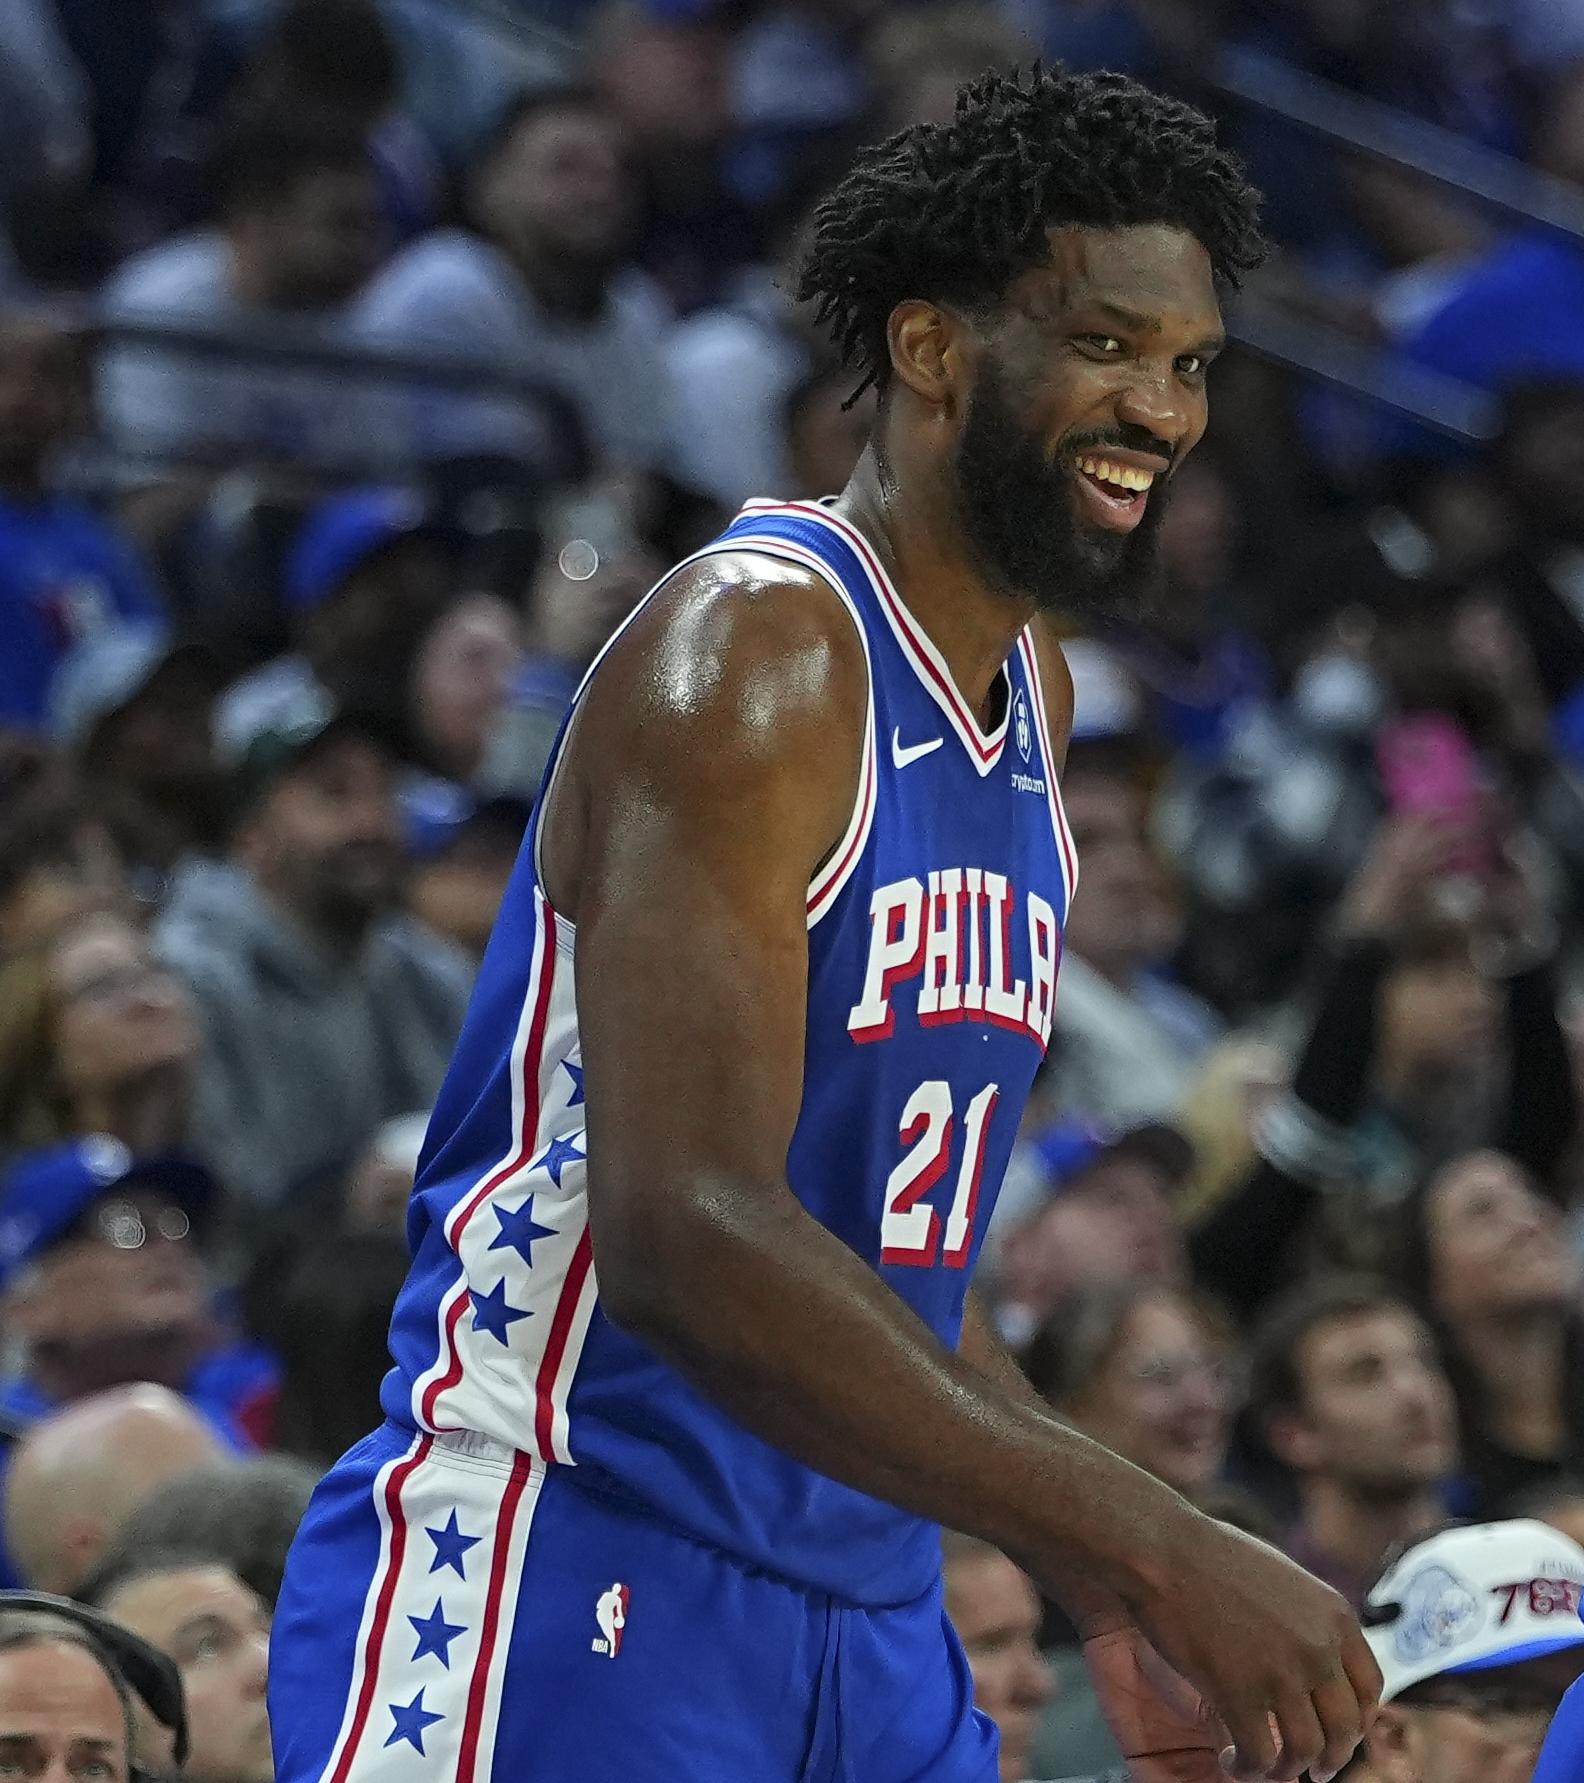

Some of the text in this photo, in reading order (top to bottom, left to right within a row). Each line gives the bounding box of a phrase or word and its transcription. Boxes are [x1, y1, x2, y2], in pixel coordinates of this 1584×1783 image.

[846, 867, 1063, 1057] PHILA
[880, 1080, 999, 1270] 21
[592, 1638, 608, 1654] NBA
